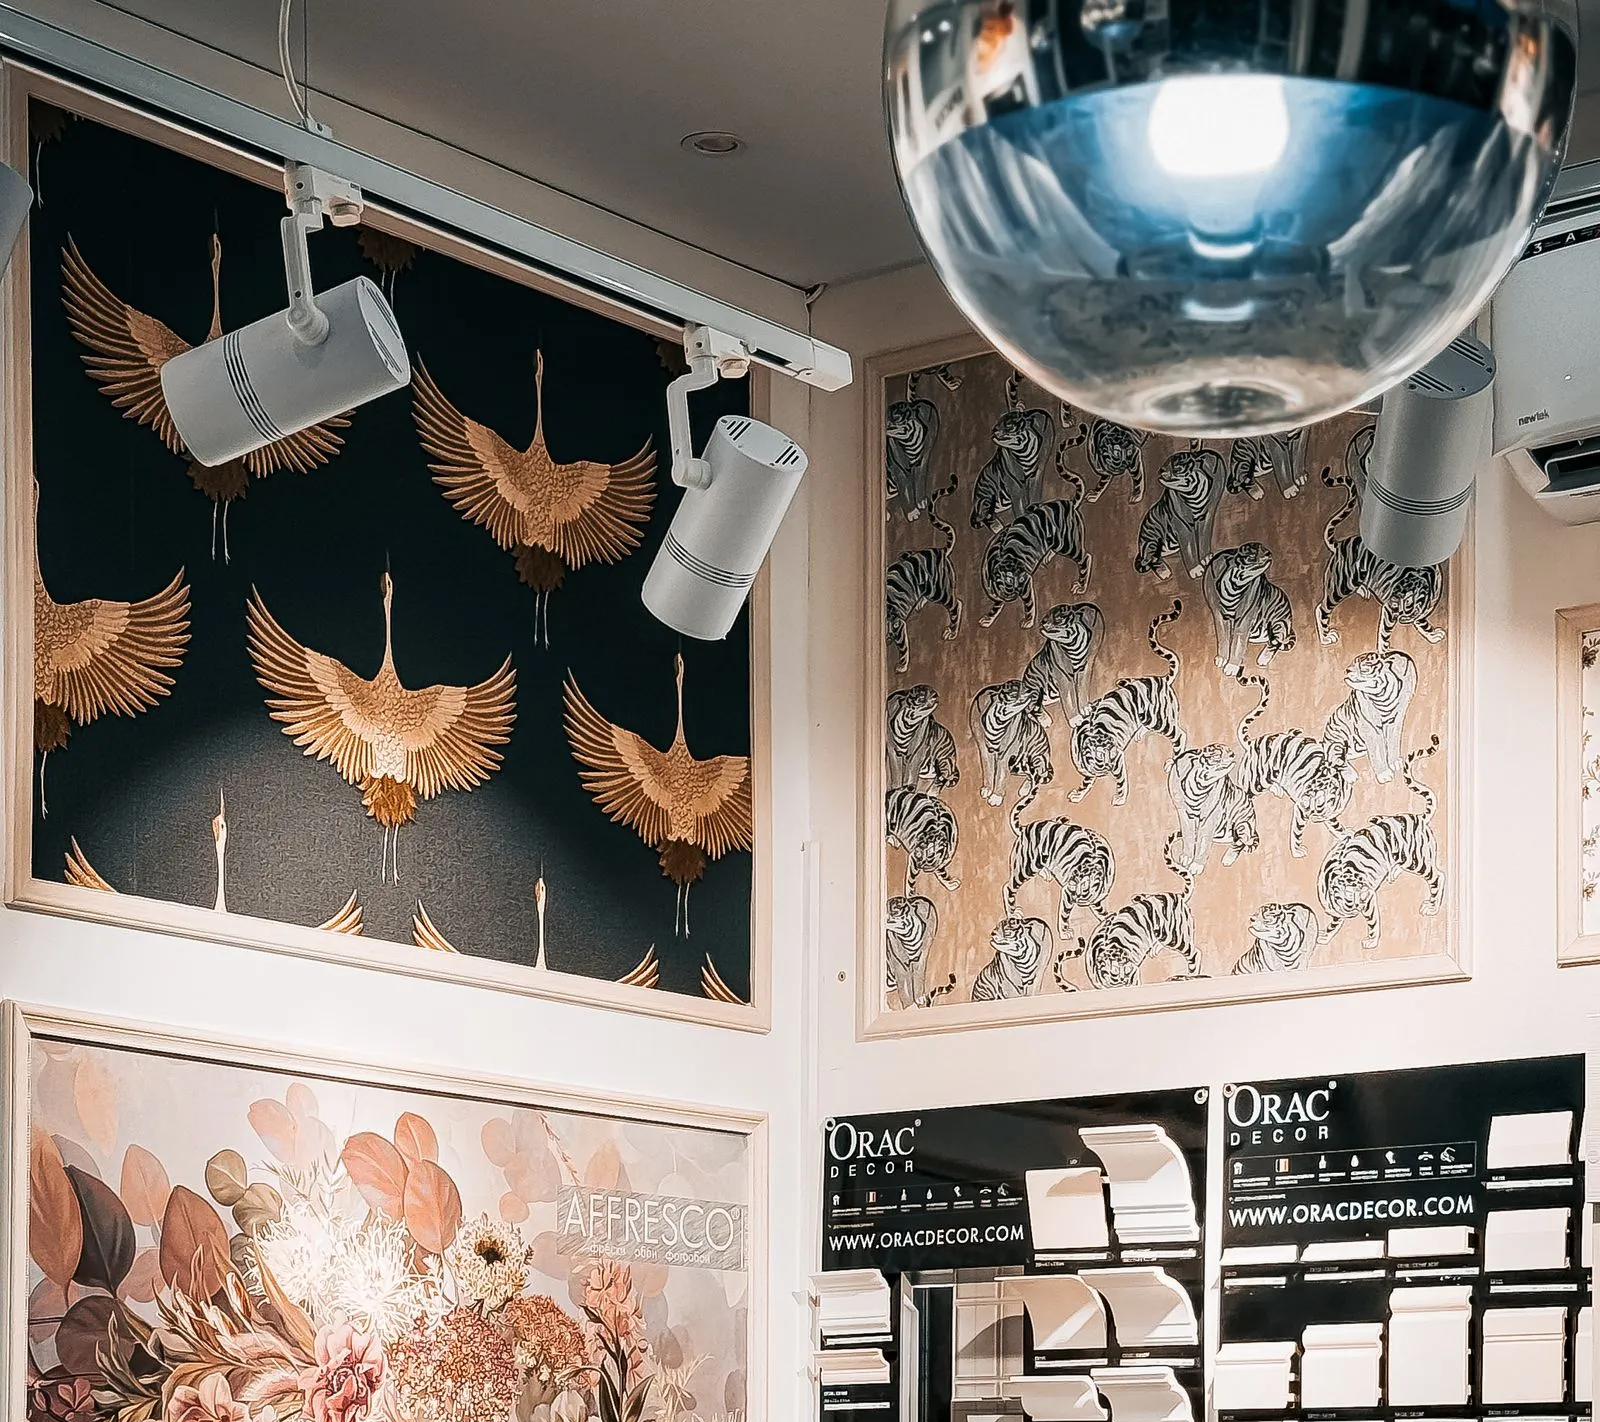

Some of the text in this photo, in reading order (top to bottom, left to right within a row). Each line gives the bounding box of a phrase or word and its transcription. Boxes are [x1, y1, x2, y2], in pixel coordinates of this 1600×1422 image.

[1230, 1125, 1329, 1147] DECOR
[830, 1159, 914, 1179] DECOR
[562, 1190, 735, 1252] AFFRESCO
[1228, 1194, 1474, 1228] WWW.ORACDECOR.COM
[828, 1224, 1025, 1252] WWW.ORACDECOR.COM
